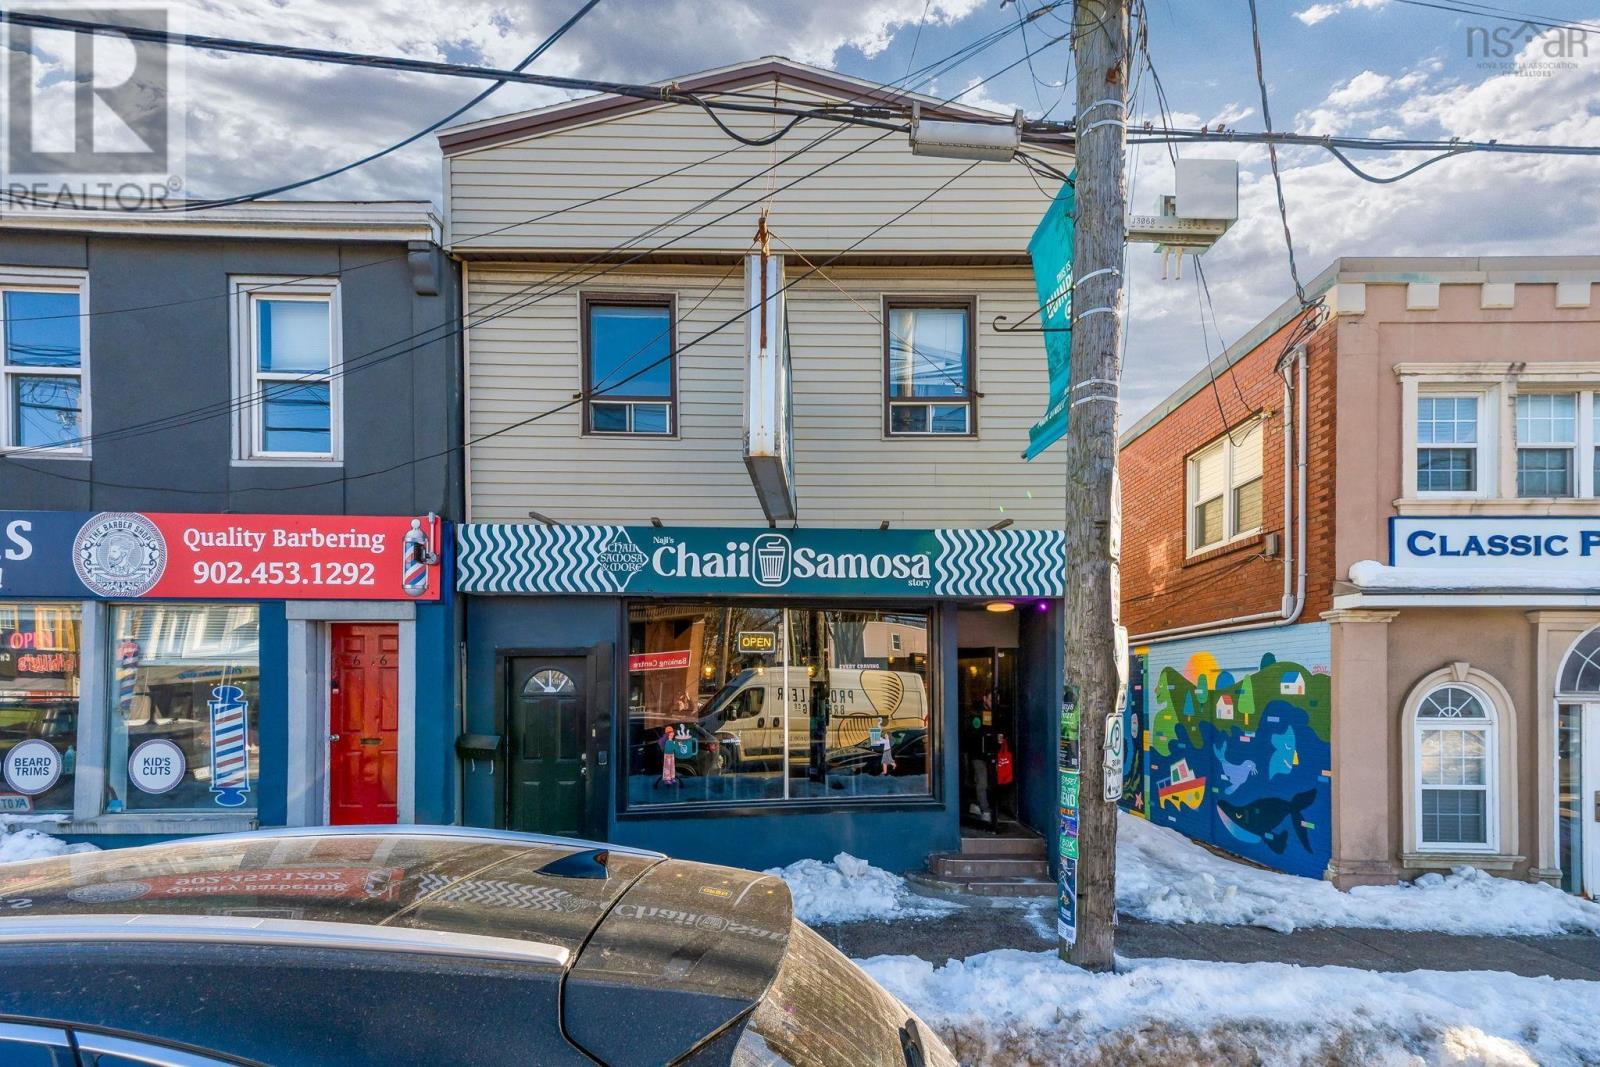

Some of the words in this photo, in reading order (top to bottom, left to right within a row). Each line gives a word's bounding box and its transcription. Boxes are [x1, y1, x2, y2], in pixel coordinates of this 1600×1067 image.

[90, 528, 104, 542] THE
[103, 521, 133, 532] BARBER
[134, 525, 152, 542] SHOP
[183, 527, 267, 552] Quality
[272, 528, 387, 553] Barbering
[652, 536, 675, 545] Naji's
[652, 541, 751, 578] Chaii
[792, 547, 932, 579] Samosa
[193, 560, 376, 585] 902.453.1292
[908, 578, 931, 589] story
[742, 636, 772, 648] OPEN
[14, 757, 52, 767] BEARD
[143, 757, 171, 766] KID'S
[15, 766, 50, 776] TRIMS
[142, 766, 171, 776] CUTS
